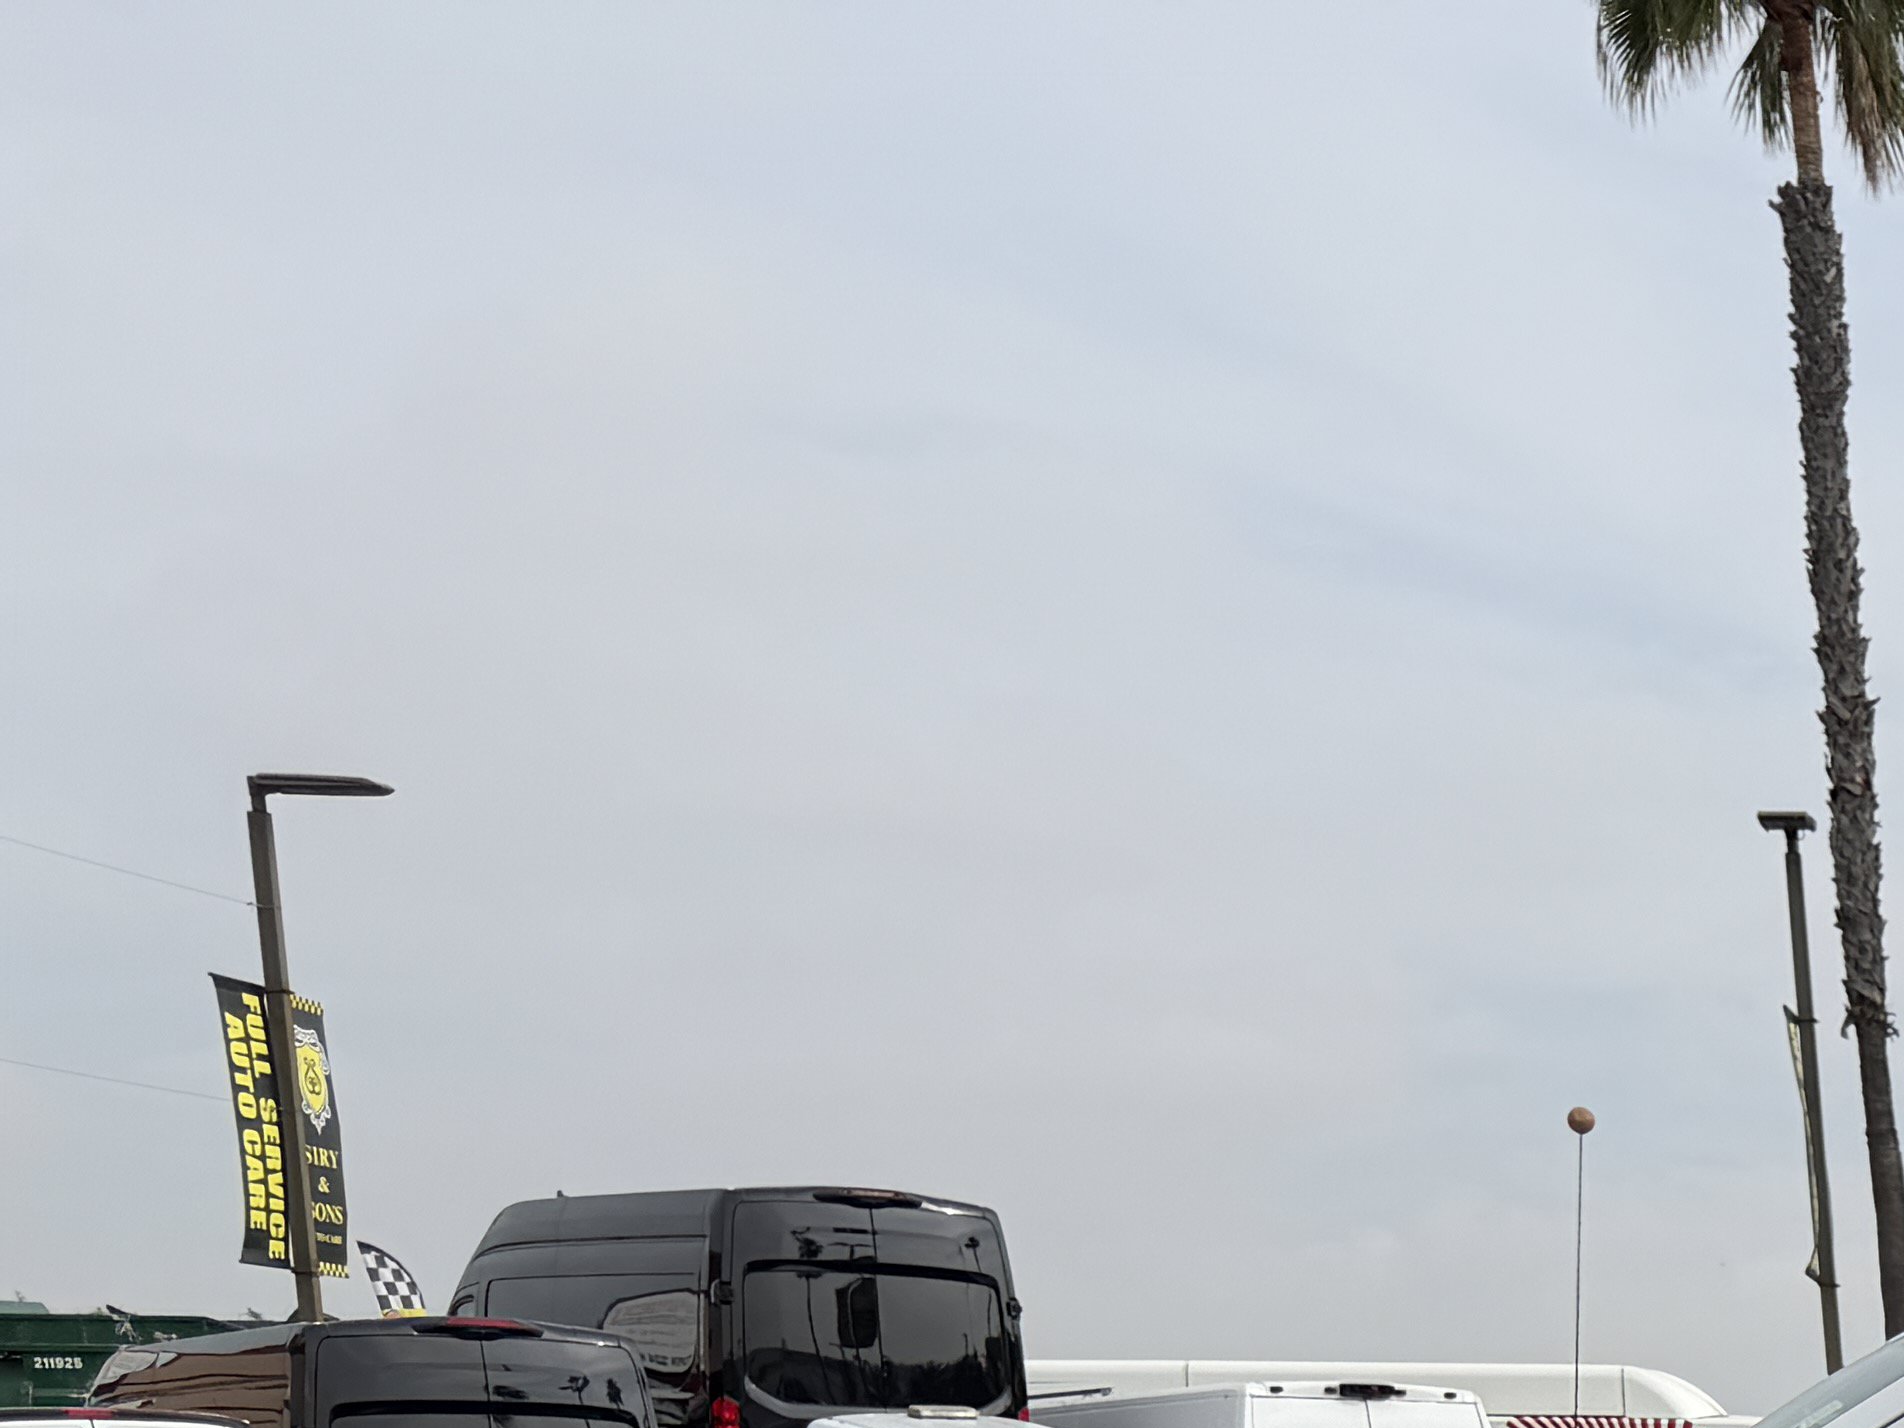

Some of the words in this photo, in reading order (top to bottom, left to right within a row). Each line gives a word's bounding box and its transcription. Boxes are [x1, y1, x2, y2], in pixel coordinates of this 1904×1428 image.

[224, 1011, 257, 1119] AUTO
[243, 1128, 268, 1230] CARE
[242, 992, 271, 1078] FULL
[259, 1097, 286, 1260] SERVICE
[318, 1177, 330, 1193] &
